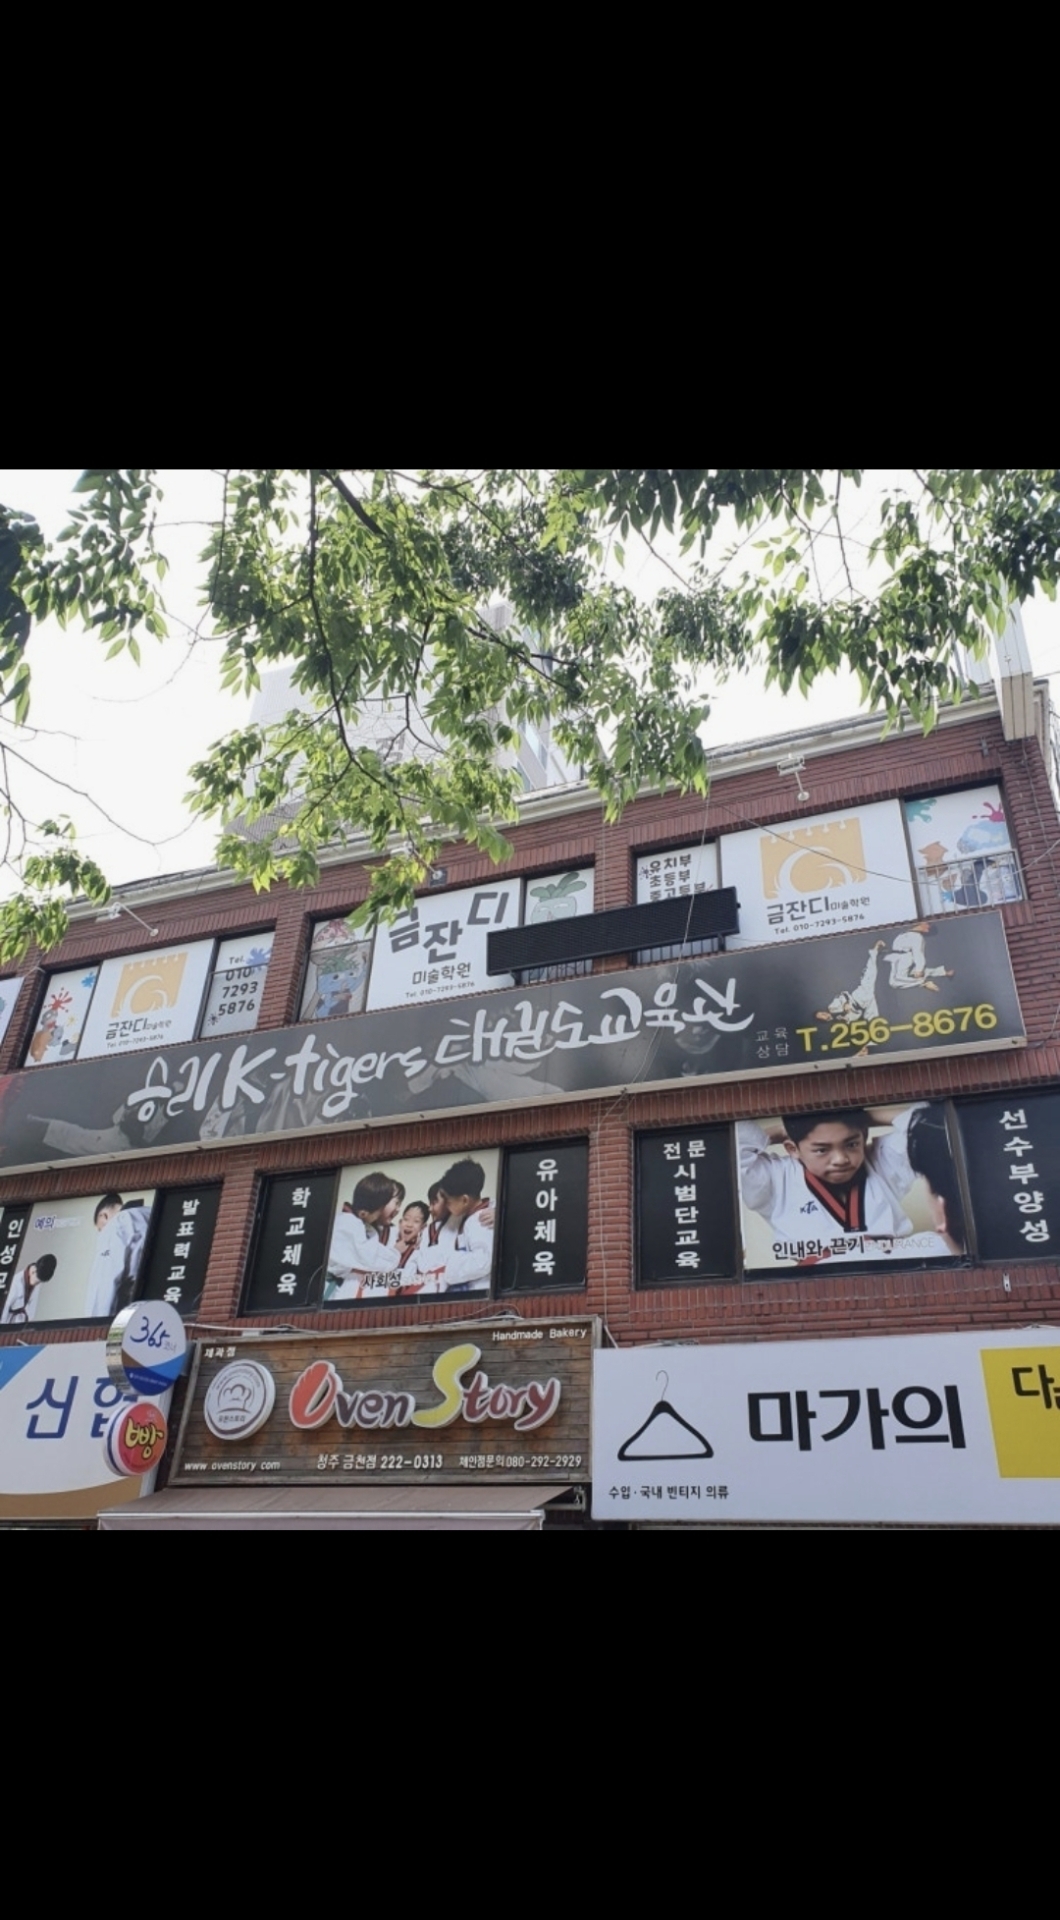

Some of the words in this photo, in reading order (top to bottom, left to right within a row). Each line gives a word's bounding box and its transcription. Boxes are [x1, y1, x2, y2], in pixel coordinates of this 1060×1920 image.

[649, 854, 691, 873] 유치부
[649, 869, 690, 888] 초등부
[767, 896, 829, 925] 금잔디
[830, 897, 870, 911] 미술학원
[793, 914, 865, 931] 010-7293-5876
[225, 967, 252, 981] 010
[412, 962, 471, 985] 미술학원
[222, 981, 258, 999] 7293
[218, 999, 255, 1016] 5876
[106, 1018, 148, 1040] 금잔디
[999, 1109, 1051, 1243] 선수부양성
[531, 1158, 558, 1276] 유아체육
[673, 1163, 701, 1269] 시범단교육
[276, 1187, 311, 1296] 학교체육
[772, 1239, 823, 1260] 인내와
[362, 1271, 402, 1290] 사회성
[492, 1329, 544, 1341] Handmade
[549, 1327, 588, 1339] Bakery
[288, 1359, 415, 1430] Oven
[412, 1342, 560, 1431] Story
[1011, 1364, 1060, 1411] 다
[747, 1384, 966, 1452] 마가의
[124, 1416, 164, 1459] 빵
[342, 1453, 377, 1470] 금천점
[380, 1454, 443, 1470] 222-0313
[666, 1485, 701, 1500] 빈티지
[705, 1485, 729, 1500] 의류
